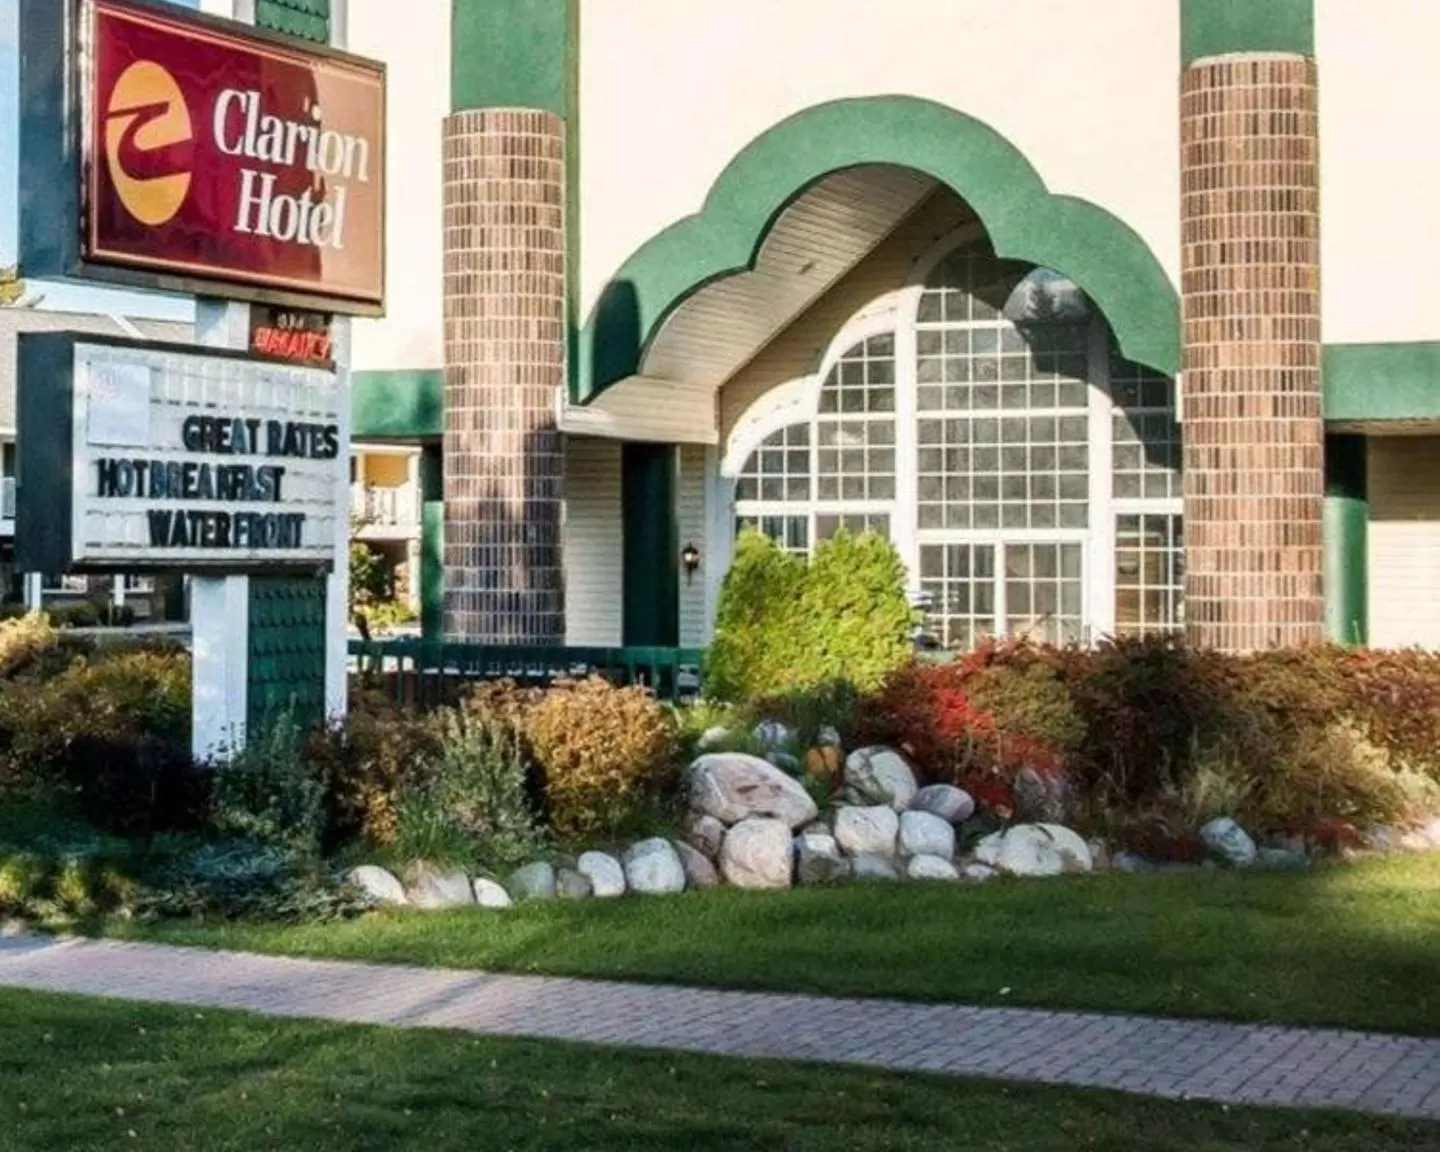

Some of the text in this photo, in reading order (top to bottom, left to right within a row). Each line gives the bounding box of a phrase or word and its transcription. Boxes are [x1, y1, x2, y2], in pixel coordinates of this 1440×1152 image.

[212, 88, 370, 182] Clarion
[233, 168, 348, 249] Hotel
[182, 415, 339, 459] GREAT RATES
